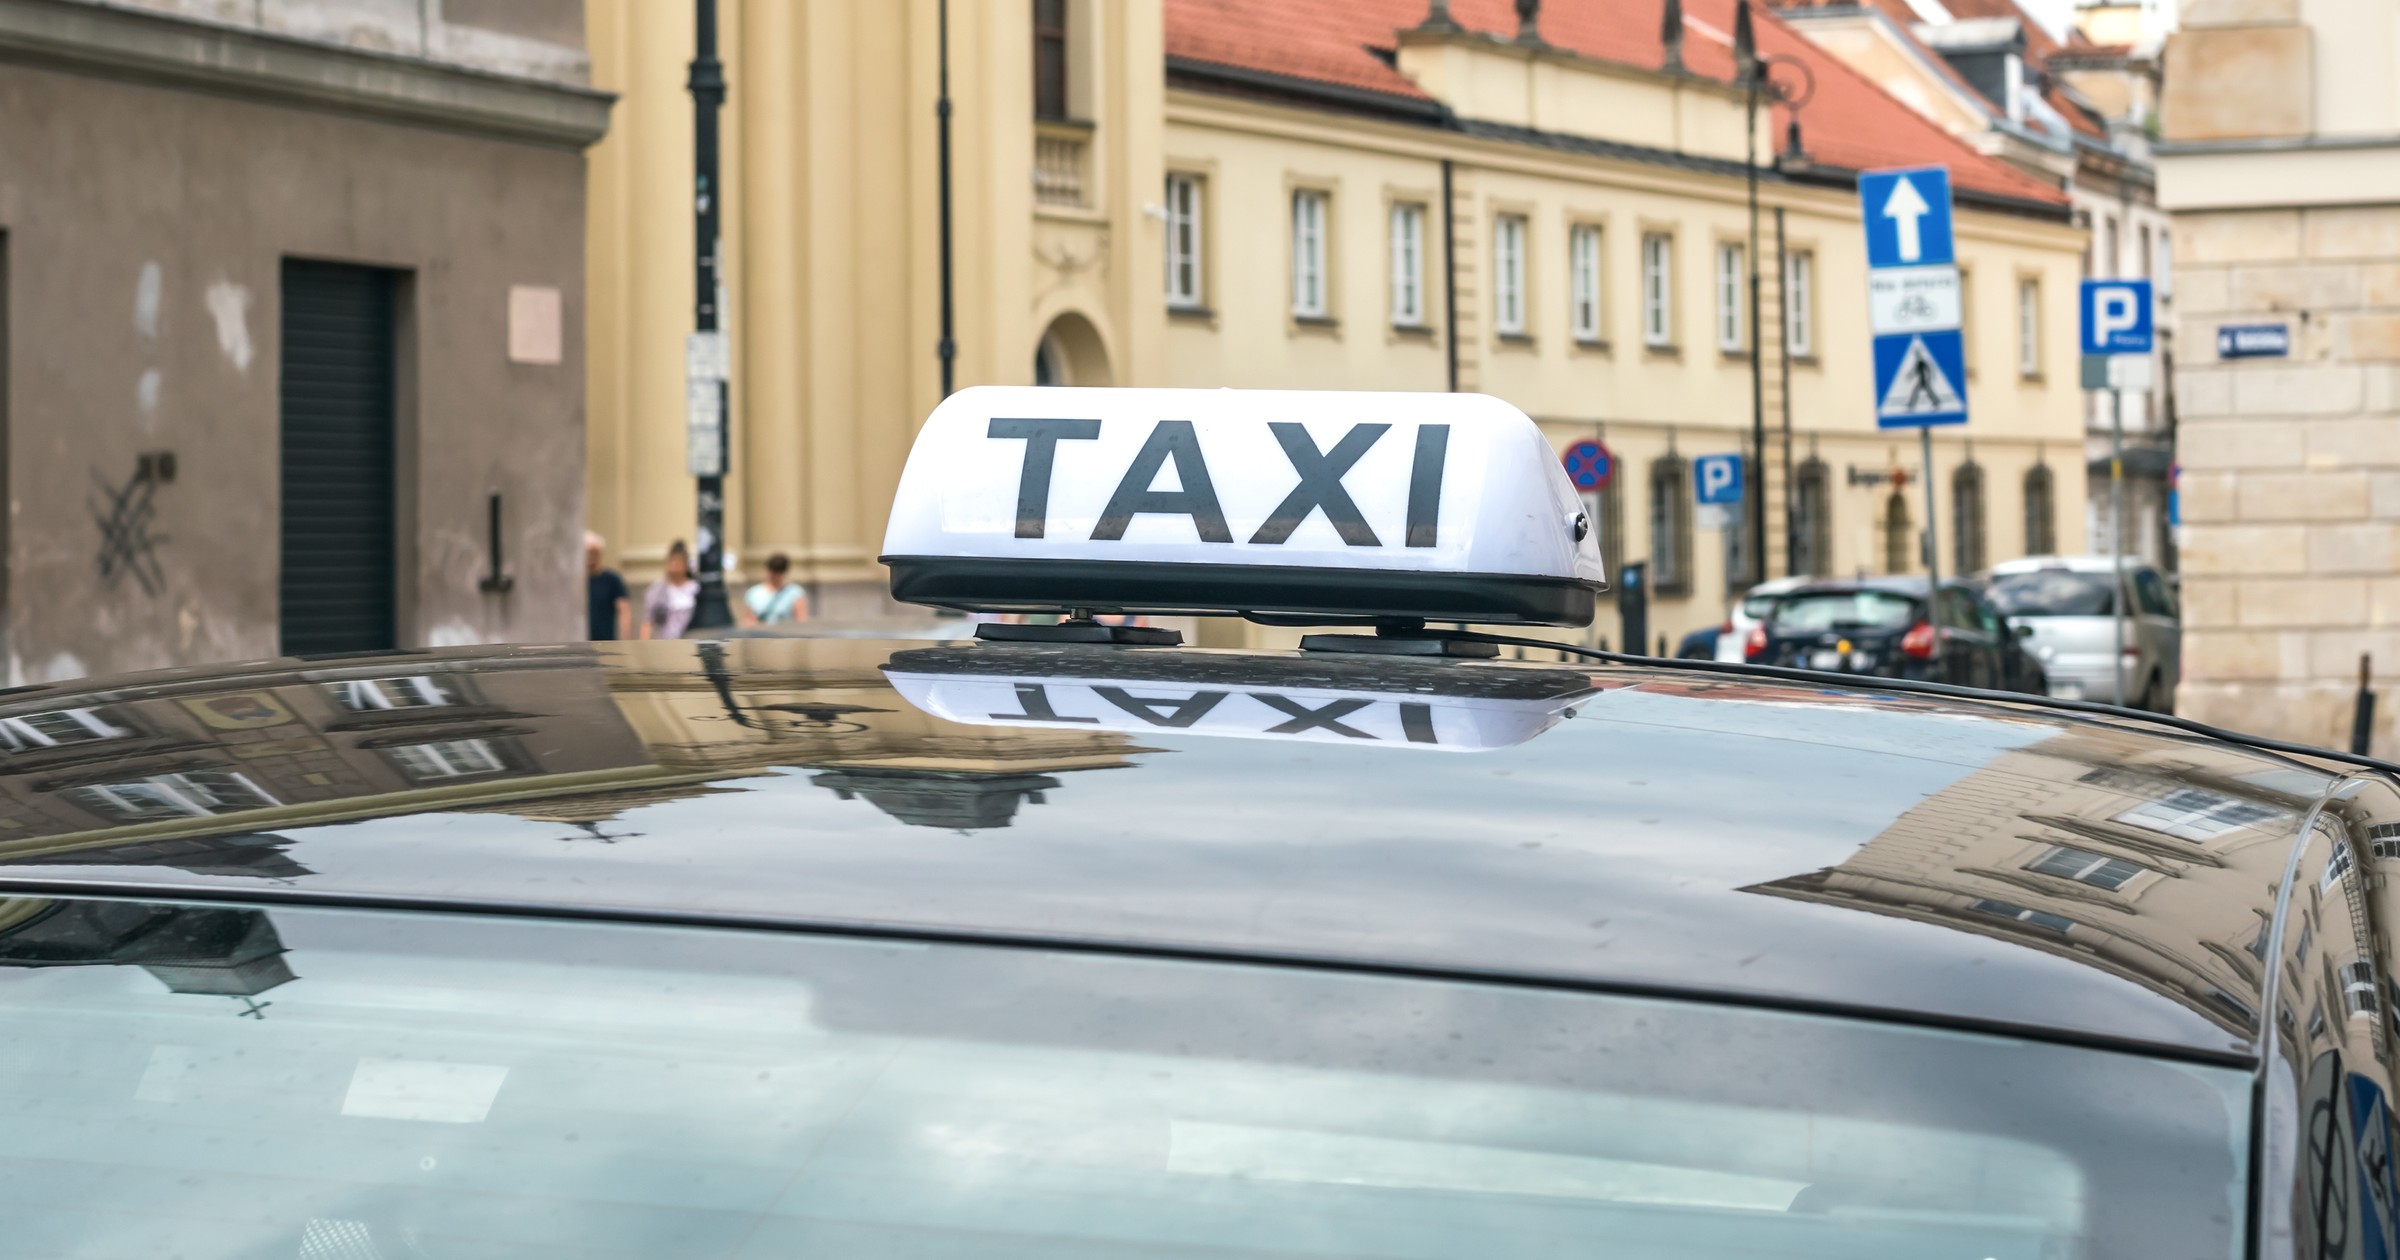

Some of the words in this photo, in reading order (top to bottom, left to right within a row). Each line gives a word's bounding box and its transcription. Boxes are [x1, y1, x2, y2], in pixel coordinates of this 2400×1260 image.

[2094, 287, 2138, 346] P
[987, 418, 1450, 547] TAXI
[1704, 459, 1732, 498] P
